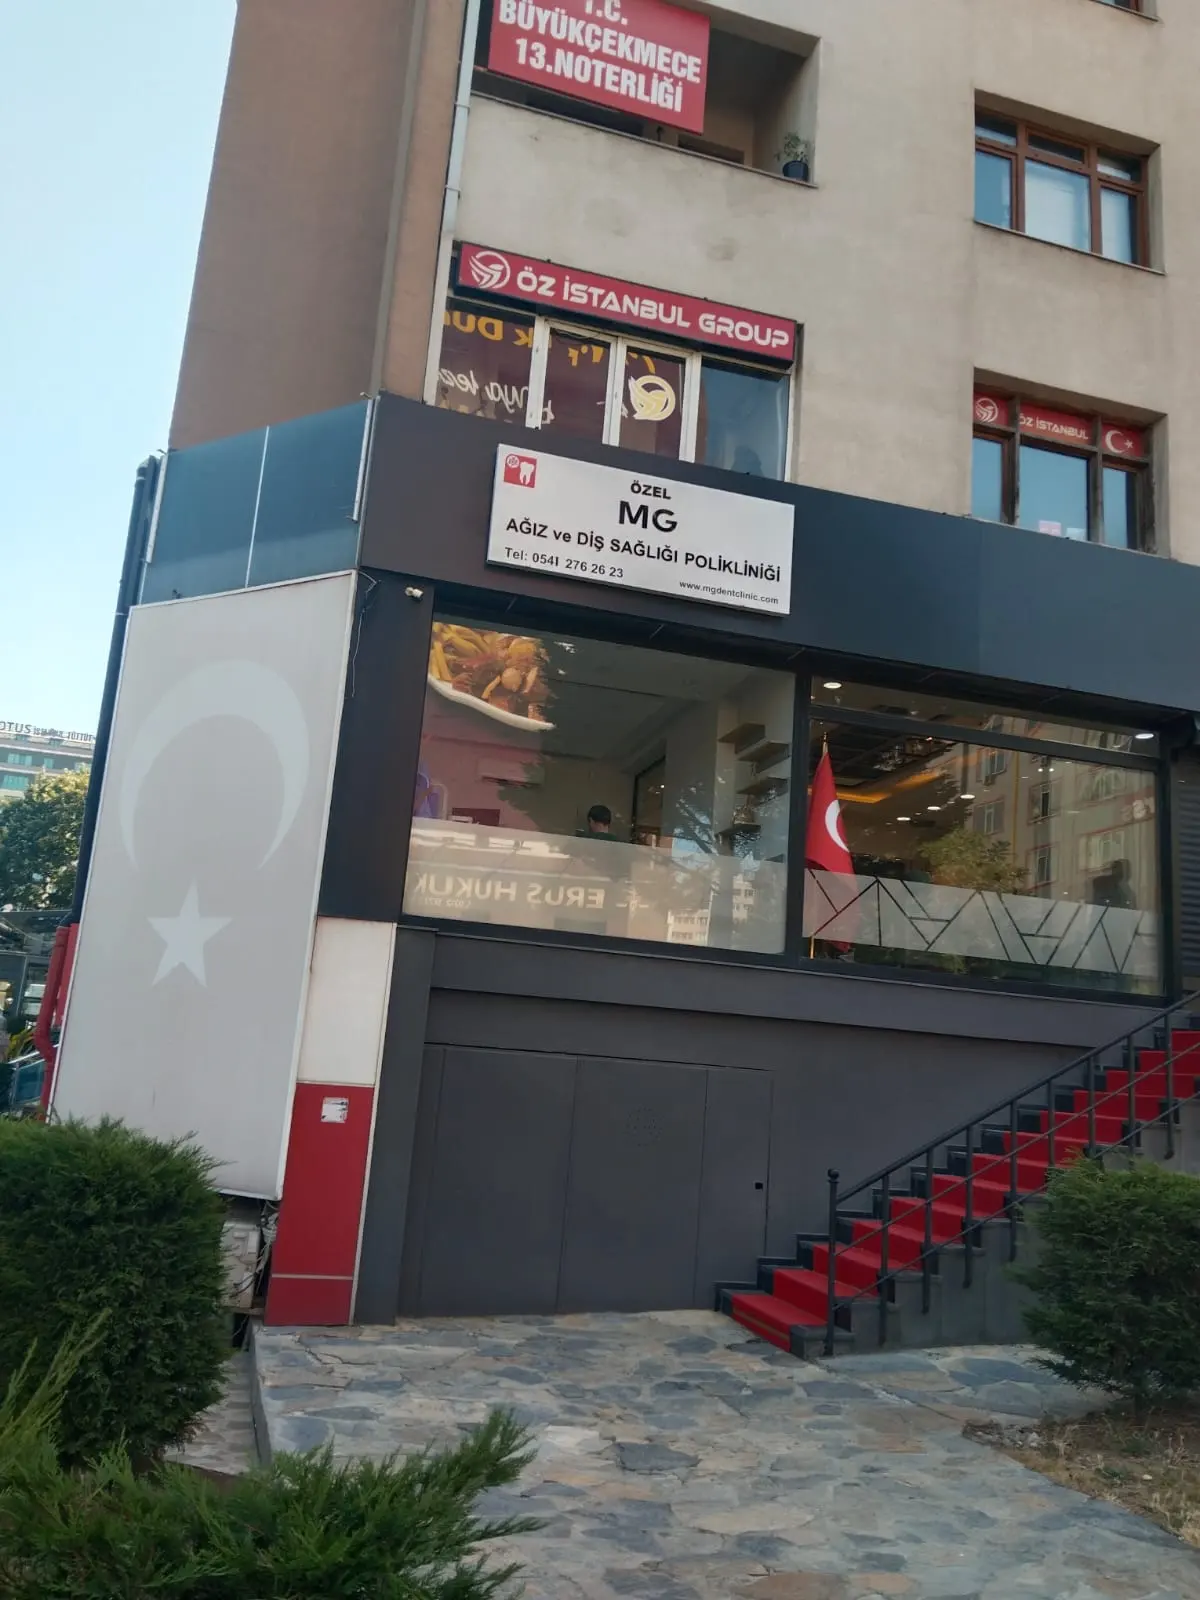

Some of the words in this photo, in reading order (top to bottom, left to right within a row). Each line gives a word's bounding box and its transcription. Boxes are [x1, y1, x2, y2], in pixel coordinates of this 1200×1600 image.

[499, 0, 702, 84] BÜYÜKÇEKMECE
[516, 38, 683, 113] 13.NOTERLİĞİ
[516, 266, 556, 297] ÖZ
[563, 275, 691, 327] İSTANBUL
[698, 313, 789, 348] GROUP
[1036, 416, 1089, 440] İSTANBUL
[630, 480, 671, 500] ÖZEL
[618, 500, 677, 532] MG
[505, 547, 528, 561] Tel:
[532, 553, 559, 567] 0541
[565, 558, 587, 572] 276
[591, 563, 605, 575] 26
[609, 566, 623, 578] 23
[506, 517, 548, 538] AĞIZ
[553, 530, 571, 542] ve
[577, 530, 604, 552] DİŞ
[610, 540, 678, 563] SAĞLIĞI
[685, 552, 781, 582] POLİKLİNİĞİ
[680, 580, 779, 604] www.mgdentclinic.com
